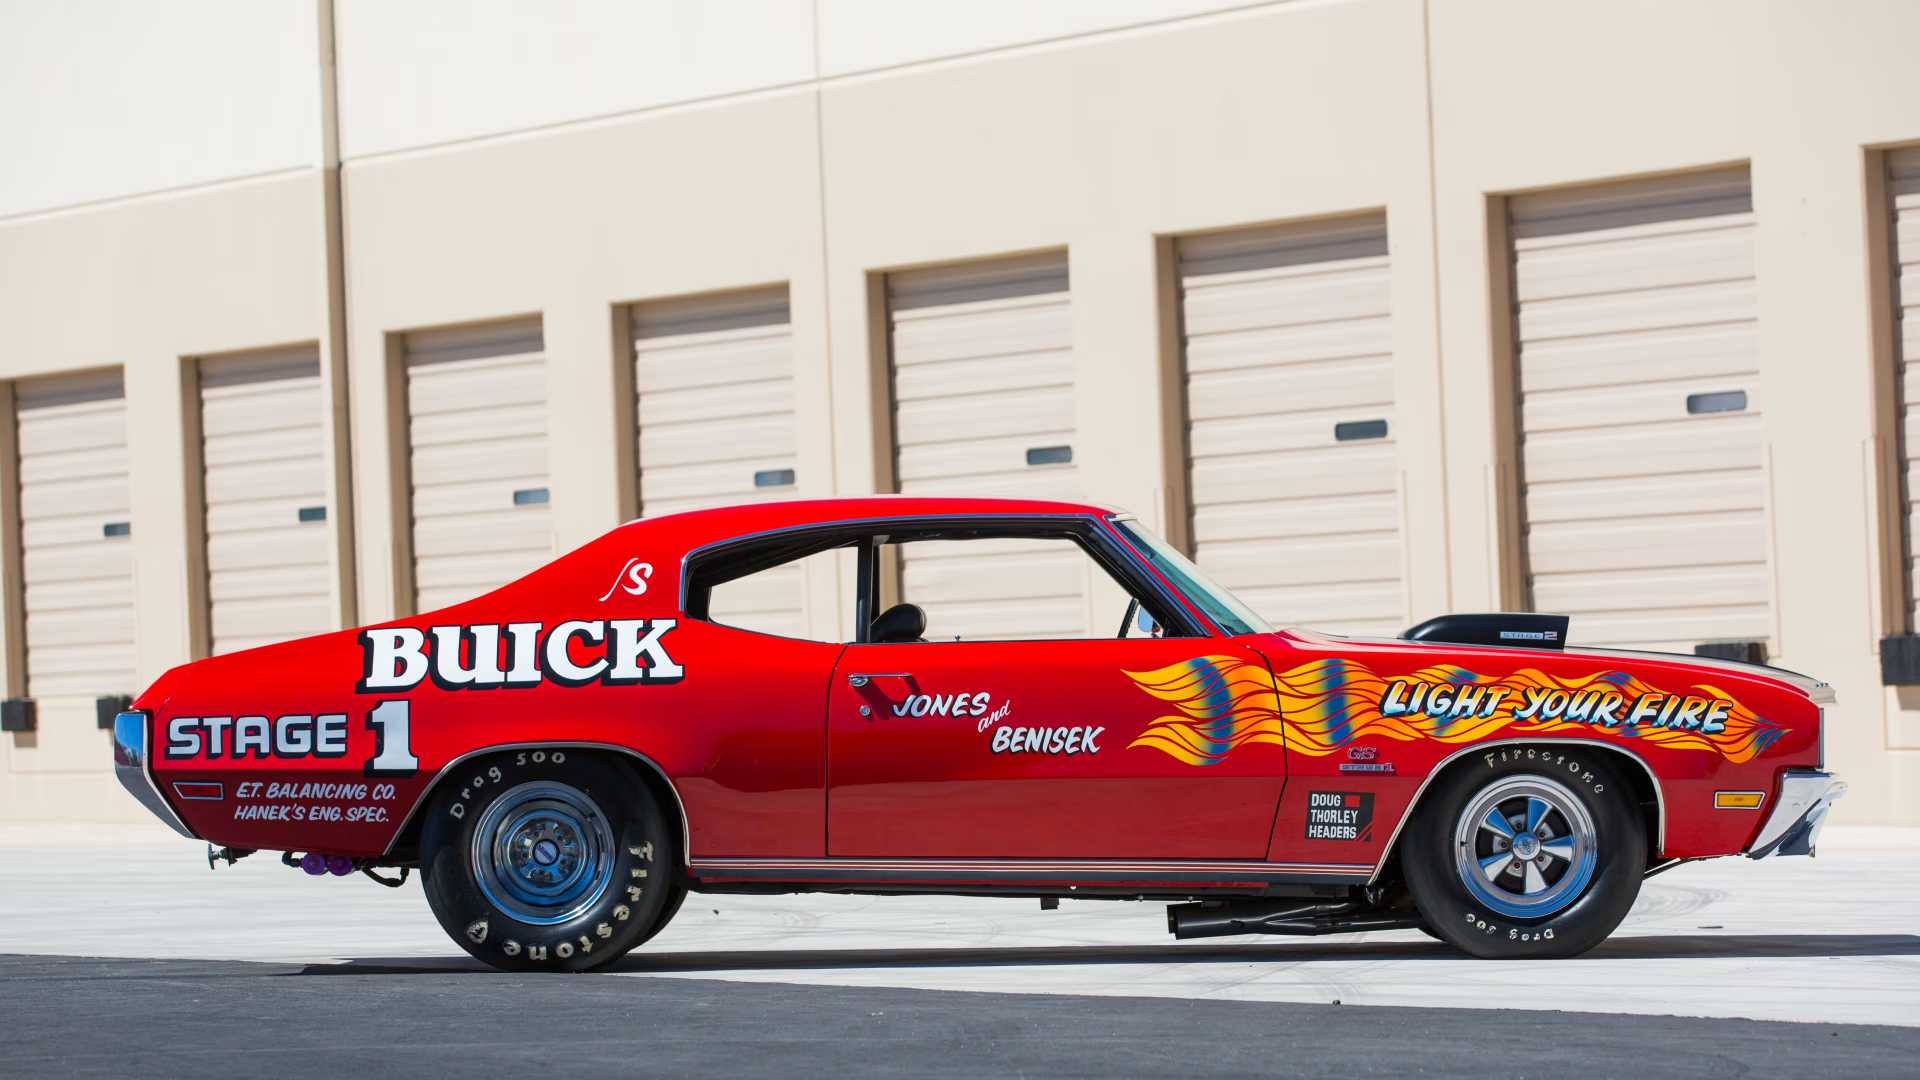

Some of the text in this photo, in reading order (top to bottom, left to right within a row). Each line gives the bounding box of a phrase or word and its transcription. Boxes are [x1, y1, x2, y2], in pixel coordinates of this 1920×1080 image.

[1544, 631, 1558, 640] 2
[358, 617, 686, 693] BUICK
[892, 691, 991, 718] JONES
[977, 699, 1012, 733] and
[1379, 680, 1734, 735] LIGHT YOUR FIRE
[165, 699, 420, 776] STAGE 1
[991, 725, 1105, 755] BENISEK
[450, 751, 566, 819] Drag 500
[1484, 748, 1604, 794] Firestone
[236, 782, 397, 801] E.T. BALANCING CO.
[1311, 793, 1342, 807] DOUG
[233, 802, 390, 822] HANEK'S ENG. SPEC.
[1310, 809, 1359, 824] THORLEY
[1308, 824, 1357, 839] HEADERS
[503, 840, 655, 961] Firestone
[1508, 927, 1555, 941] Drag
